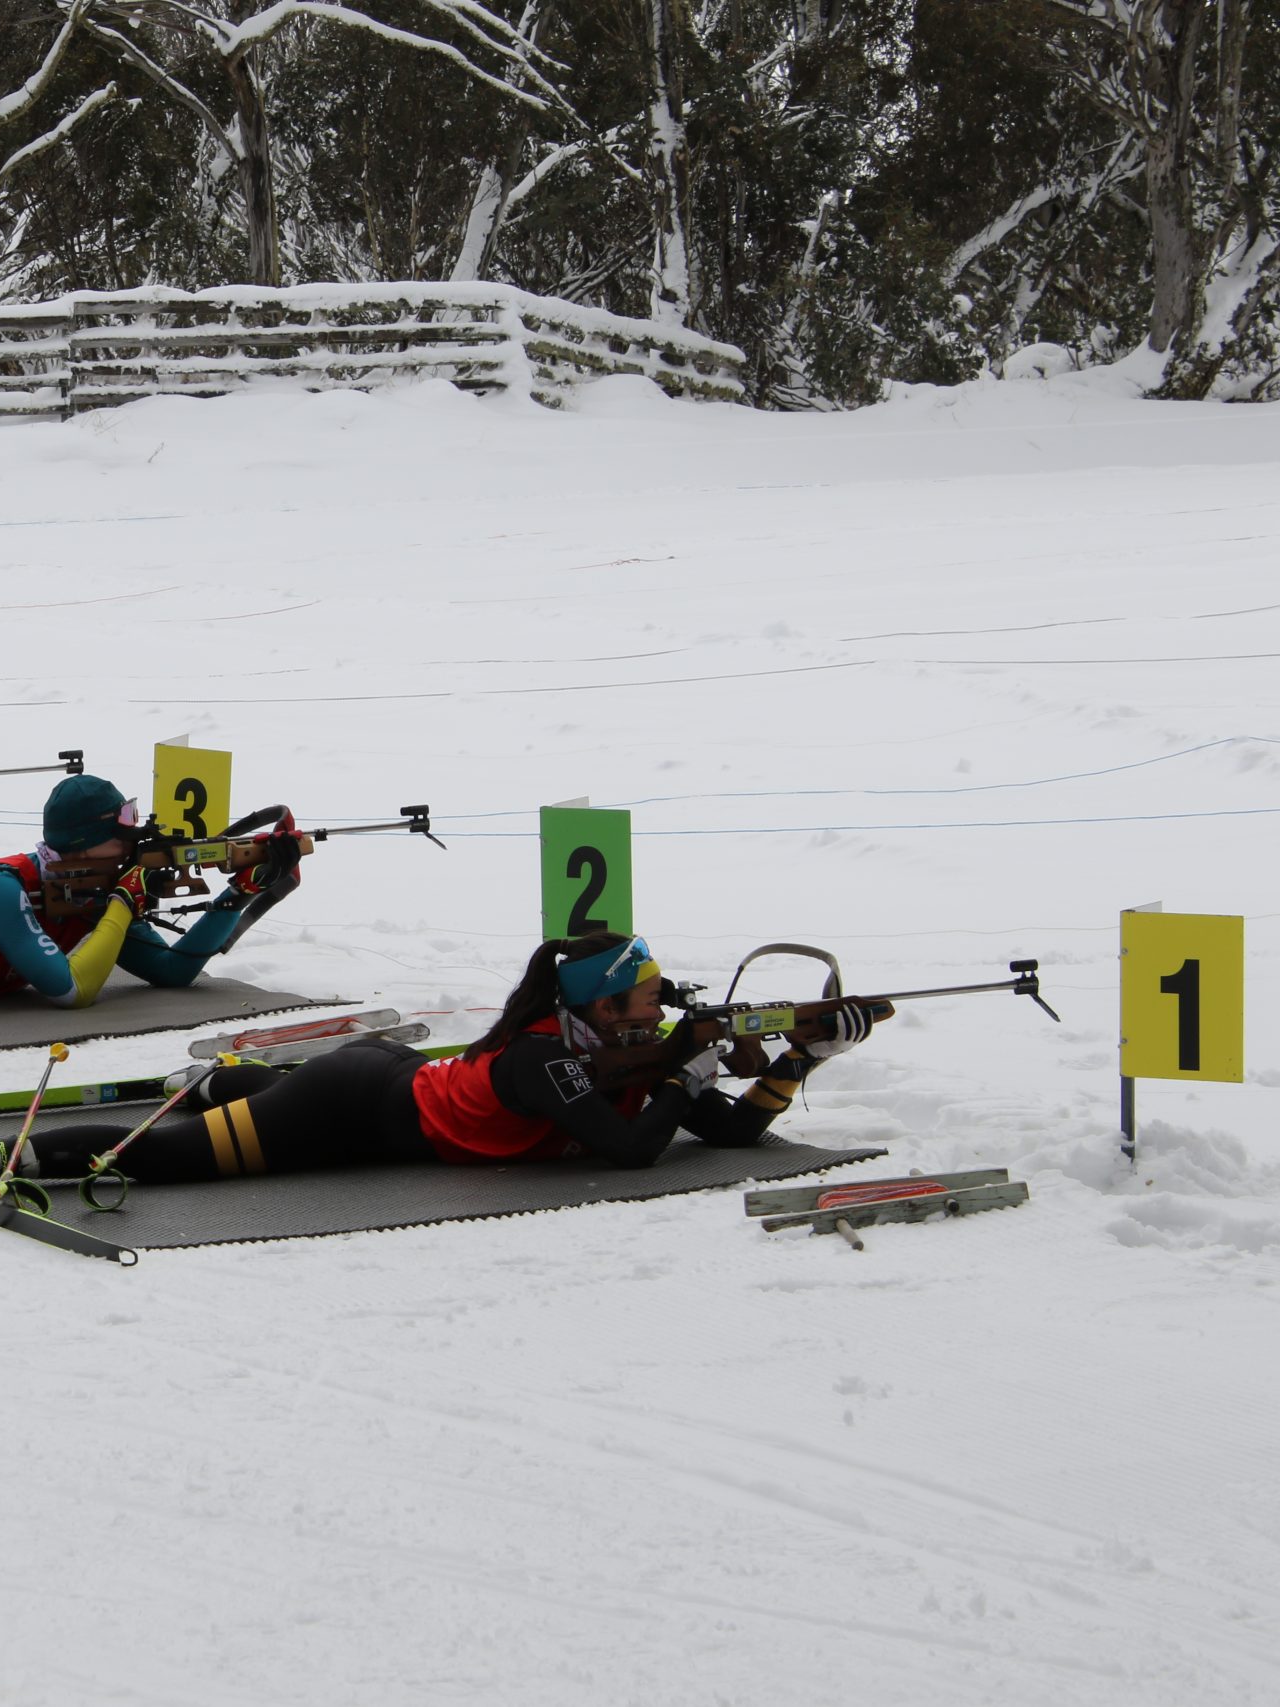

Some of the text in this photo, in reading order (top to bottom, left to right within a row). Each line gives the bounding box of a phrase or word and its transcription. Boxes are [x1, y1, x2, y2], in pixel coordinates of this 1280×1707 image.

[174, 777, 208, 840] 3
[19, 889, 59, 956] AUS
[566, 845, 608, 937] 2
[1160, 959, 1200, 1071] 1
